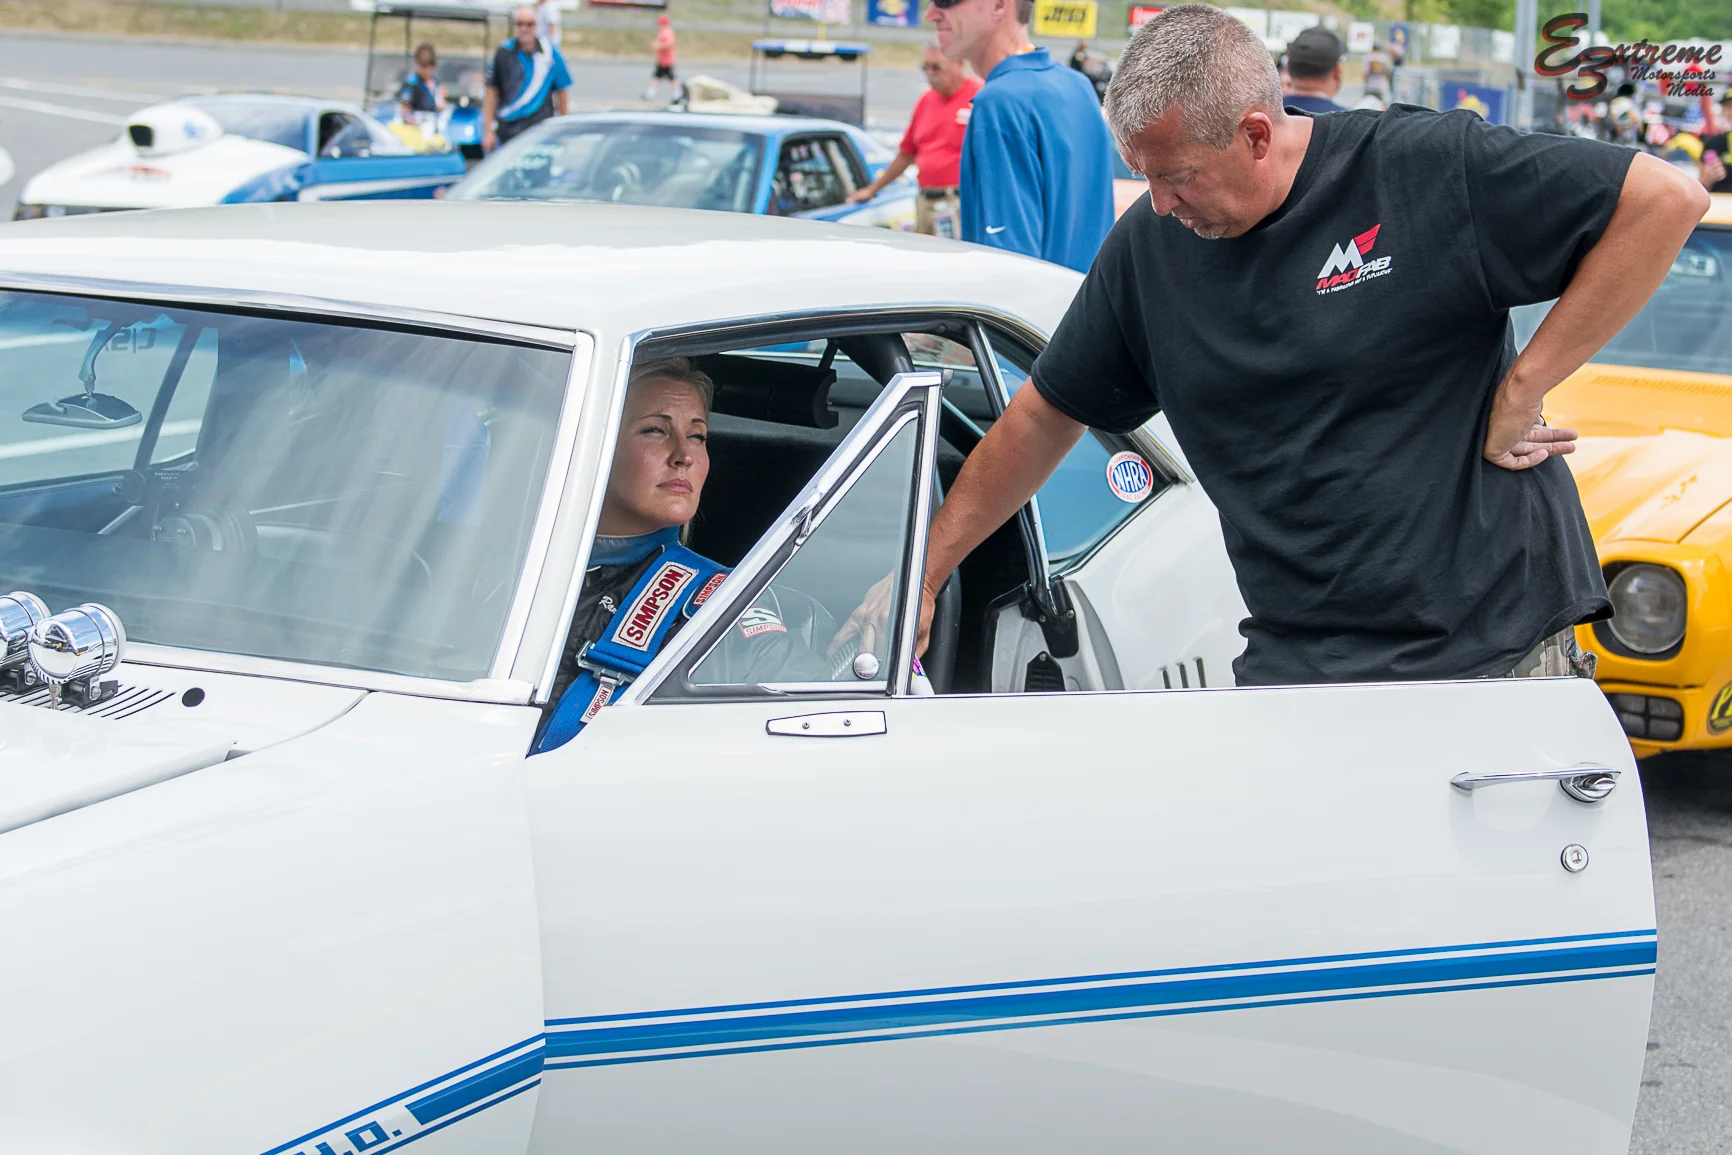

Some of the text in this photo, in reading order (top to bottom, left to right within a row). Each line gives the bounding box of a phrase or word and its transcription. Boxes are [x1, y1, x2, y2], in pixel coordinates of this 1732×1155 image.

[1114, 462, 1147, 492] NHRA
[626, 568, 684, 640] SIMPSON
[696, 574, 726, 604] SIMPSON
[745, 624, 784, 636] SIMPSON
[588, 689, 609, 717] SIMPSON
